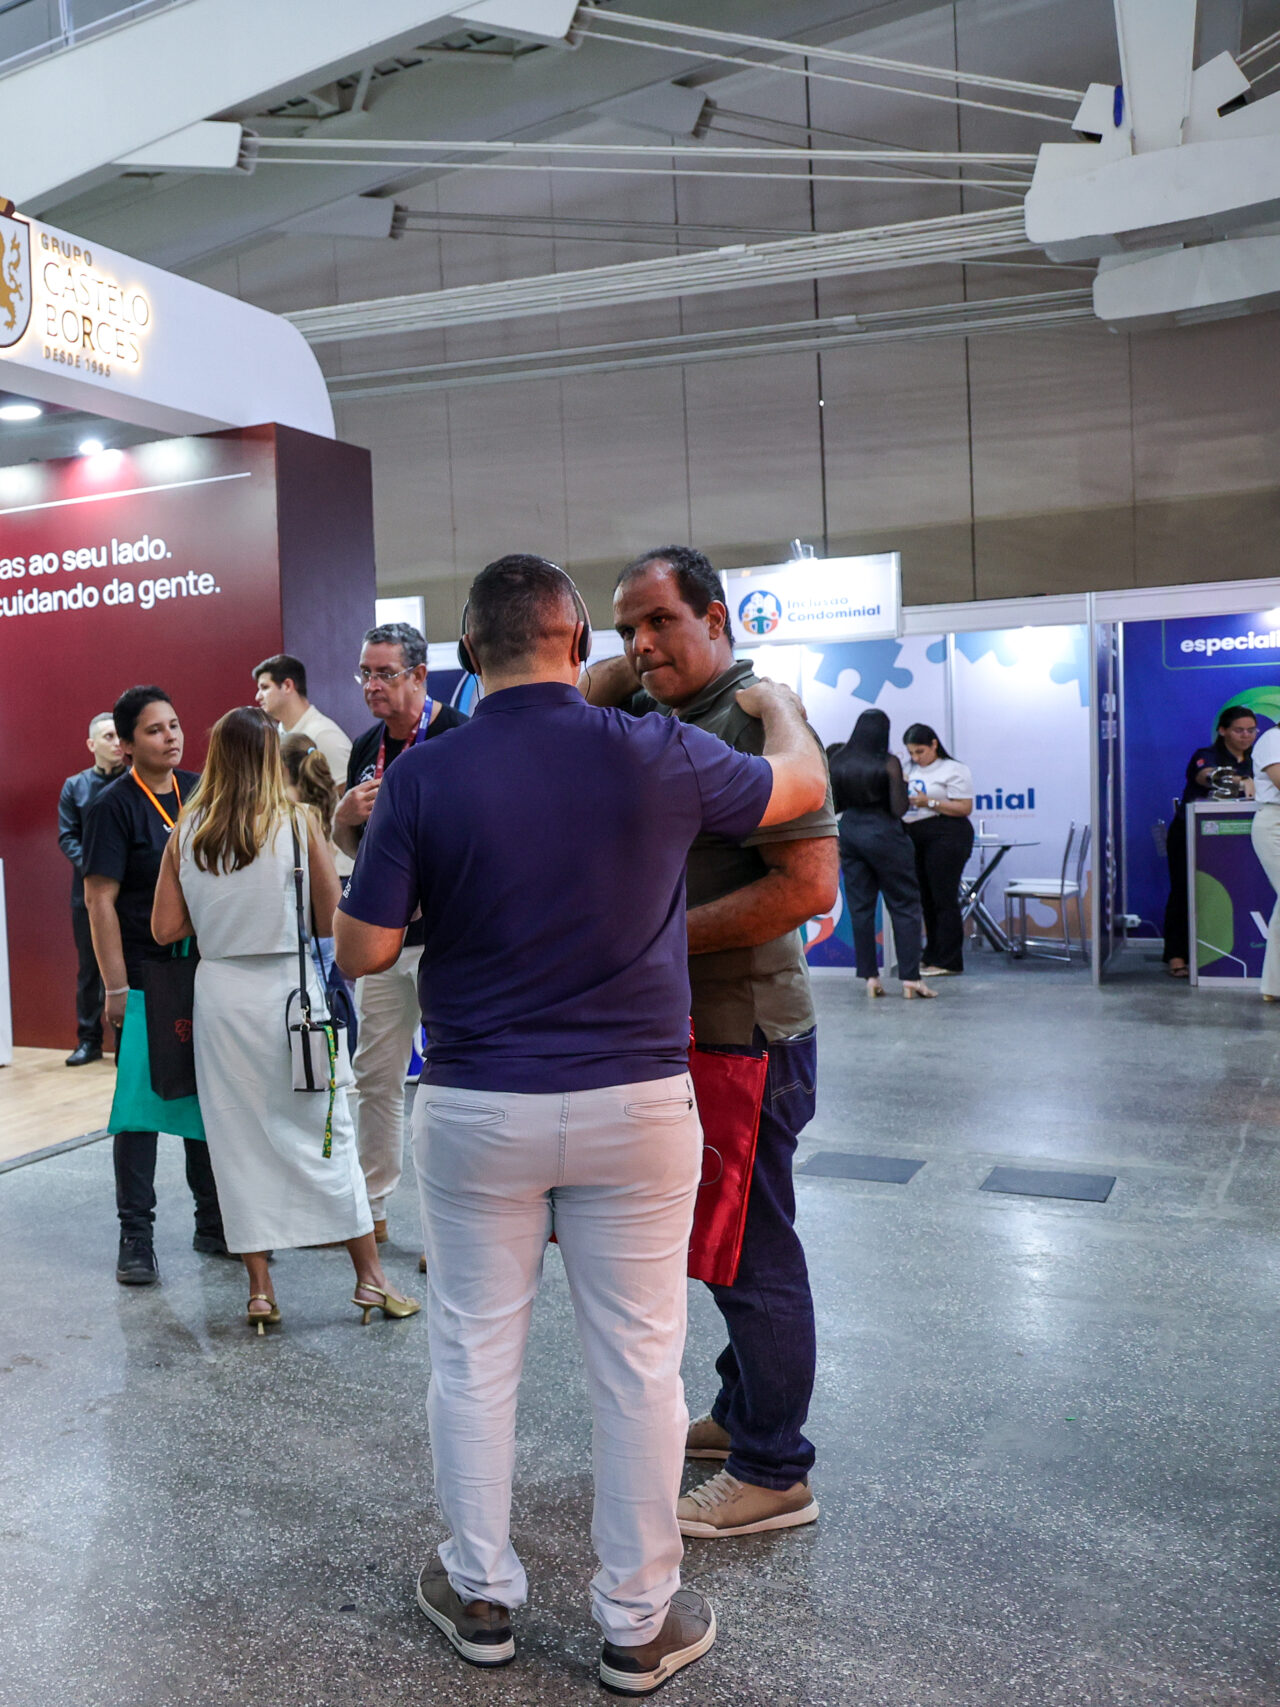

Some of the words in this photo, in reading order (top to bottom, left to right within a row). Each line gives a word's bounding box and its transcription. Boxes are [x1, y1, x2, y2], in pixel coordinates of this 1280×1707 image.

[41, 232, 92, 267] GRUPO
[43, 261, 149, 326] CASTELO
[44, 345, 81, 369] DESDE
[28, 551, 59, 576] ao
[62, 545, 107, 573] seu
[111, 534, 173, 565] lado.
[103, 578, 135, 605] da
[138, 569, 222, 610] gente.
[787, 604, 882, 622] Condominial
